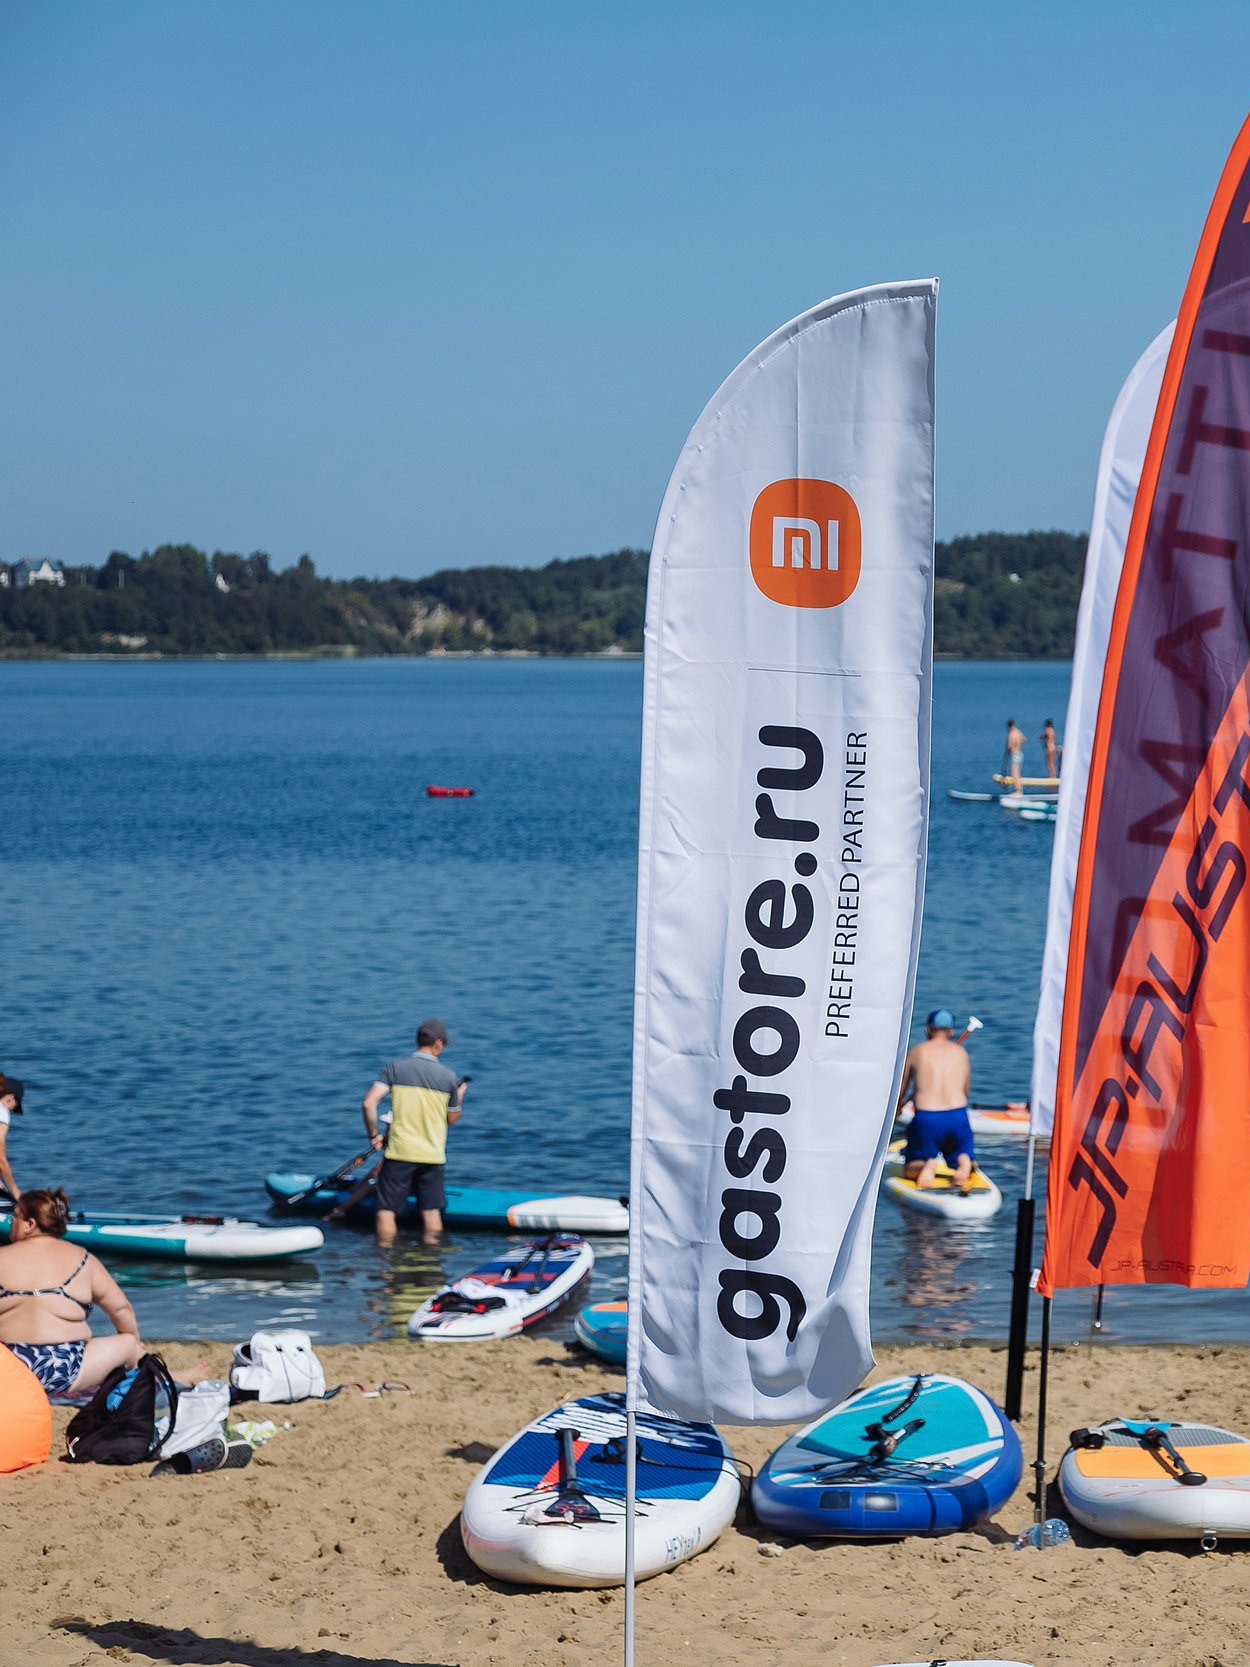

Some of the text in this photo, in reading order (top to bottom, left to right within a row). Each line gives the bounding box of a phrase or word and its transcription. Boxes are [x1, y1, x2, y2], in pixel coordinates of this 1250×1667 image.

[713, 724, 824, 1342] gastore.ru
[825, 731, 868, 1038] PREFERRED PARTNER
